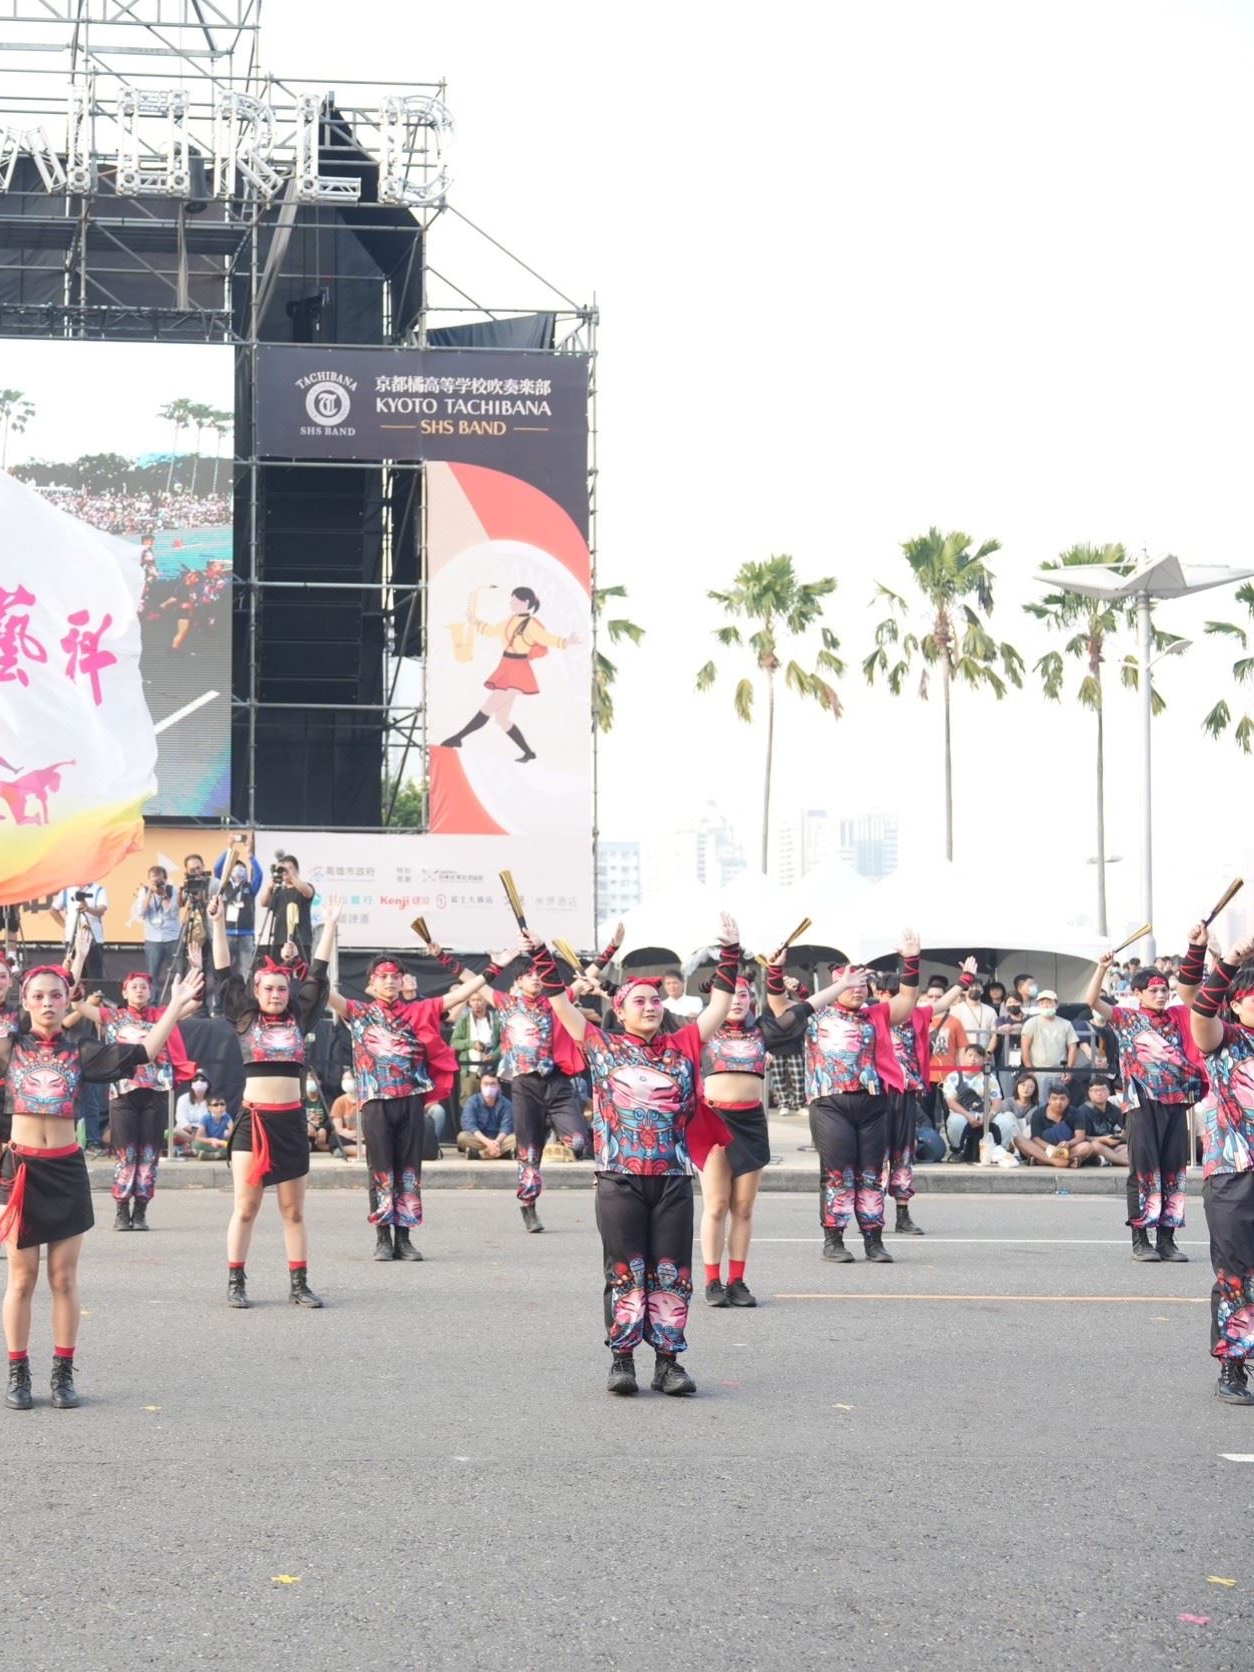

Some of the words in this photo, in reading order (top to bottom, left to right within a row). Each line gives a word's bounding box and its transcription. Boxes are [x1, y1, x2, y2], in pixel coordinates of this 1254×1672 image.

[294, 371, 358, 391] TACHIBANA
[374, 375, 552, 396] 京都橘高等学校吹奏楽部
[375, 398, 436, 415] KYOTO
[444, 398, 552, 416] TACHIBANA
[300, 426, 322, 435] SHS
[324, 427, 356, 436] BAND
[420, 419, 454, 434] SHS
[458, 420, 506, 436] BAND
[380, 895, 410, 909] Kenji
